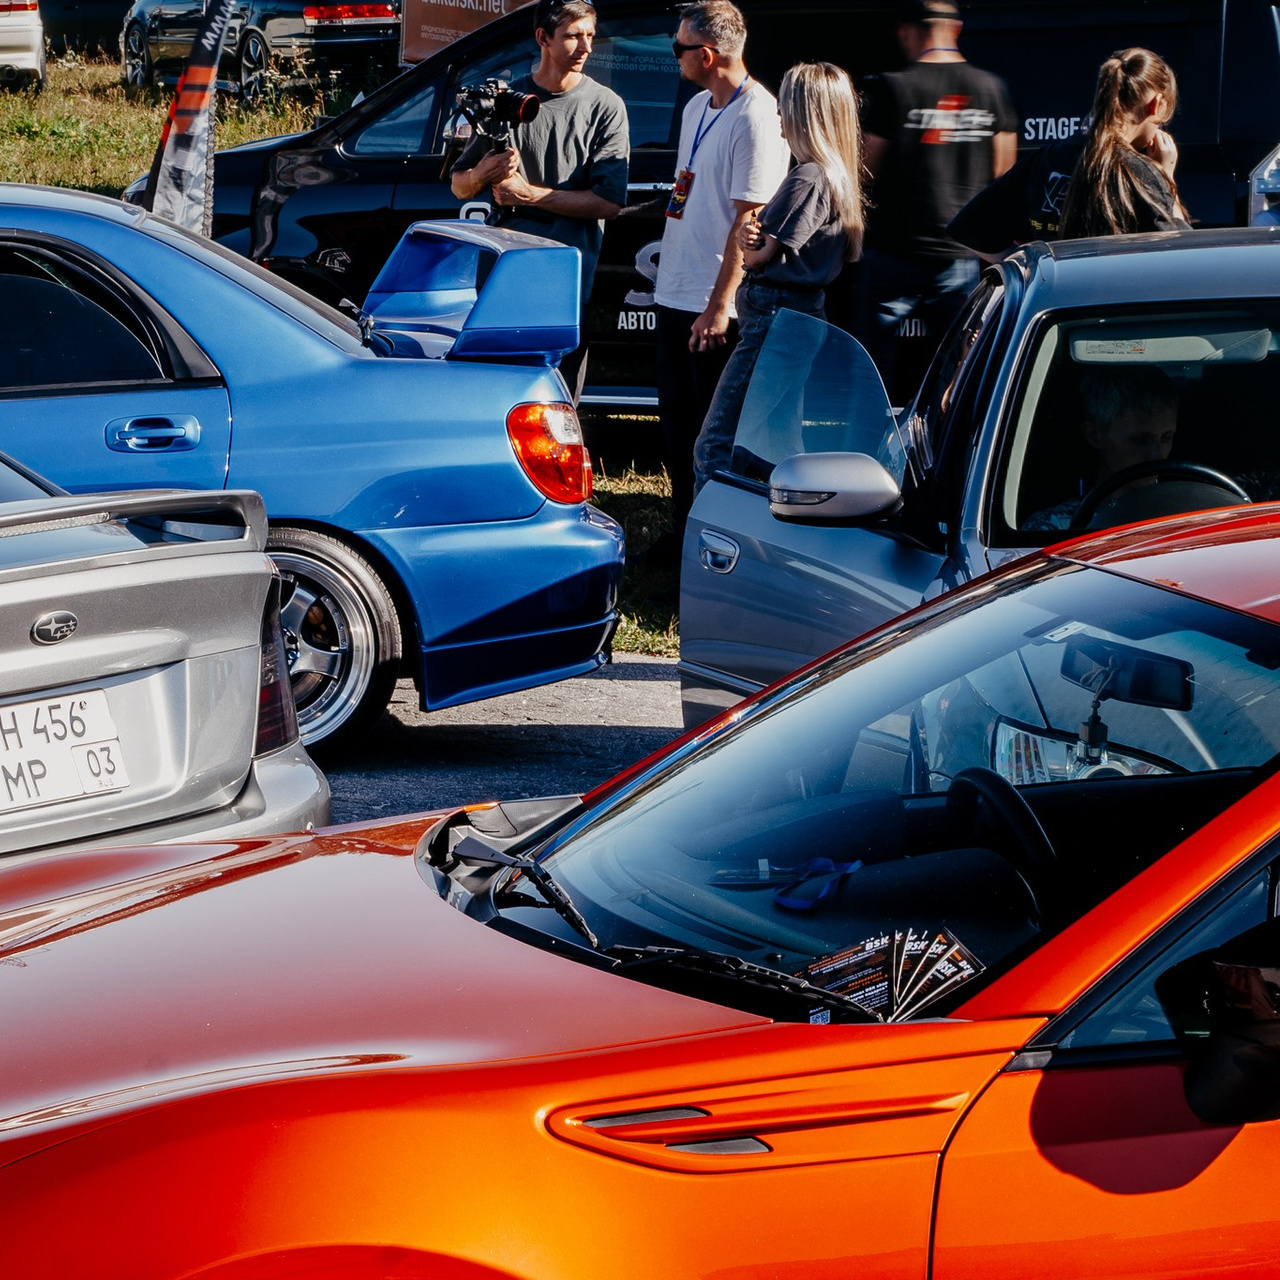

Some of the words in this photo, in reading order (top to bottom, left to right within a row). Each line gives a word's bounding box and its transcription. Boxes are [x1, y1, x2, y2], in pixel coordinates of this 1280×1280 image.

[617, 311, 657, 331] АВТО
[32, 701, 86, 744] 456
[1, 758, 47, 802] МР
[86, 746, 116, 778] 03
